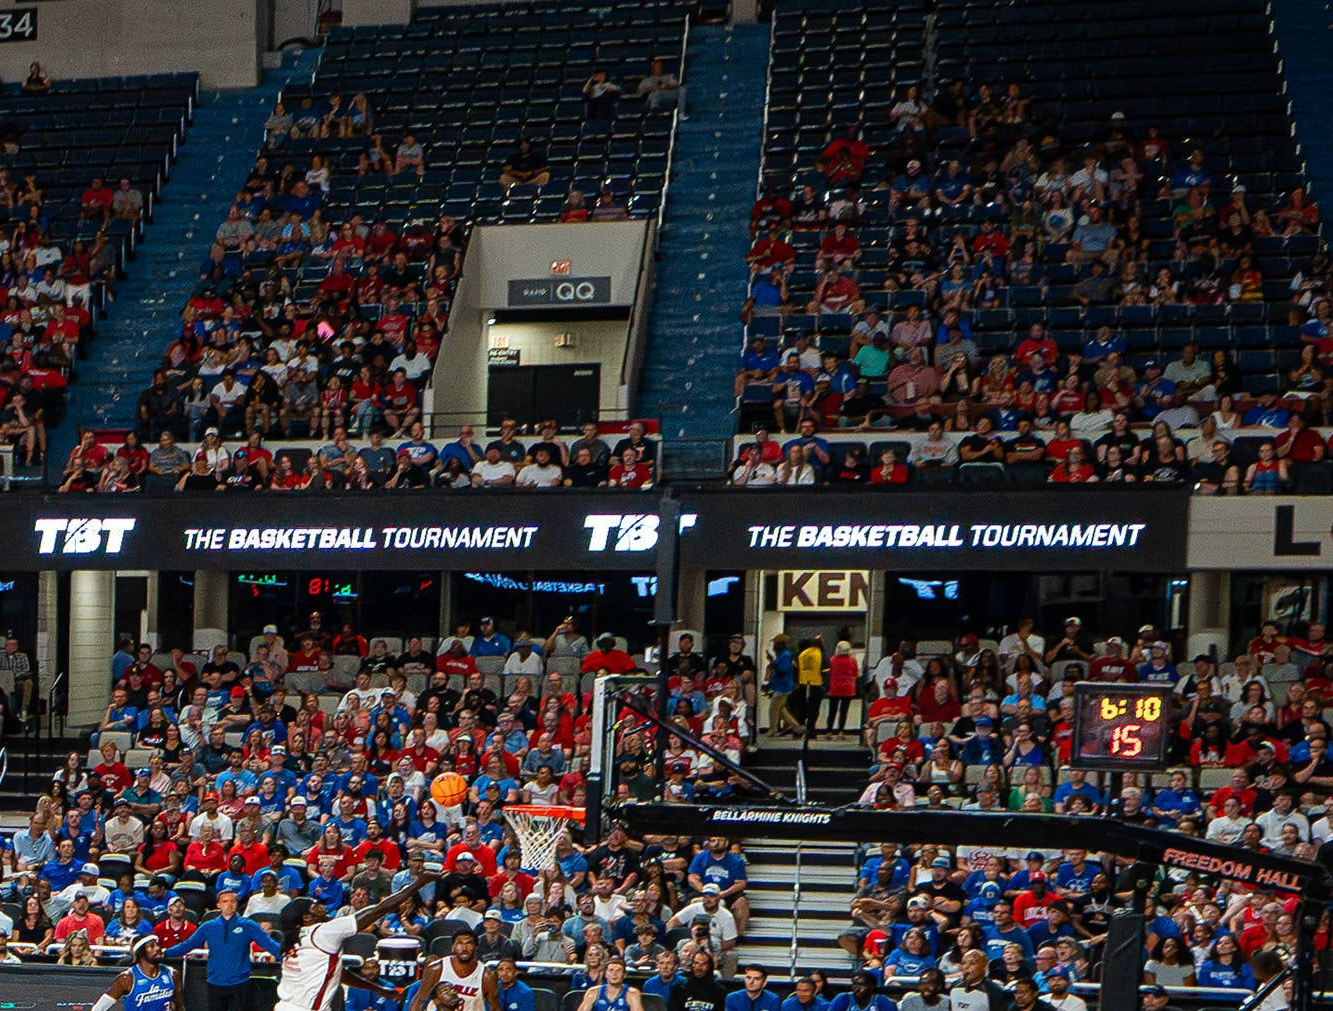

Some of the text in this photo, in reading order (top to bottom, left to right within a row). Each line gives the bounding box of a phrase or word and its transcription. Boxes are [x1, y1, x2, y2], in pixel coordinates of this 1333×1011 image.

[556, 281, 595, 301] QQ
[34, 517, 137, 555] TBT
[183, 525, 538, 551] THE BASKETBALL TOURNAMENT
[747, 522, 1147, 550] THE BASKETBALL TOURNAMENT
[1273, 504, 1322, 557] L
[782, 571, 871, 608] KEN
[1100, 696, 1162, 722] 6:10
[1110, 723, 1143, 757] 15
[713, 810, 832, 825] BELLARMINE KNIGHTS
[1162, 847, 1302, 891] FREEDOM HALL
[377, 959, 418, 978] TBT
